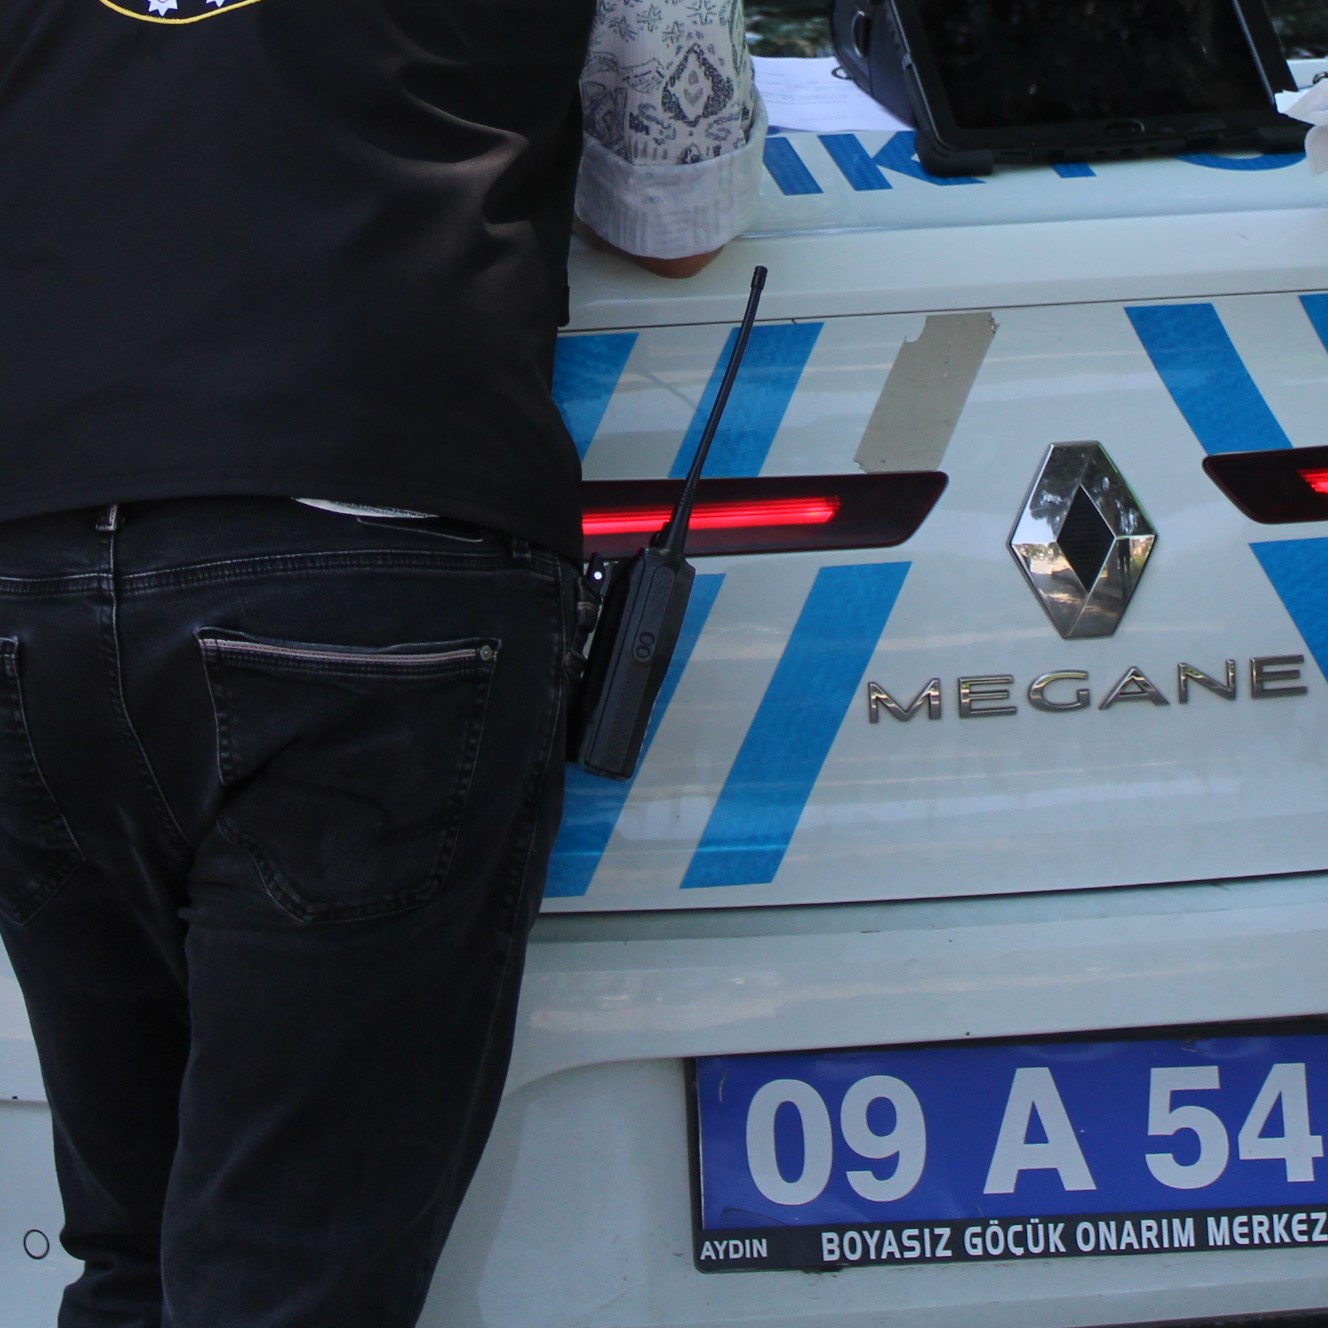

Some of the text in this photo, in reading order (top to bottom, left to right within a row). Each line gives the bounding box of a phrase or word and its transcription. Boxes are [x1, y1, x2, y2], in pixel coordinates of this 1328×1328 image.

[867, 655, 1309, 725] MEGANE
[744, 1074, 928, 1207] 09
[983, 1066, 1097, 1195] A
[699, 1238, 768, 1261] AYDIN
[820, 1227, 953, 1262] BOYASIZ
[963, 1218, 1067, 1257] GÖÇÜK
[1075, 1217, 1197, 1252] ONARIM
